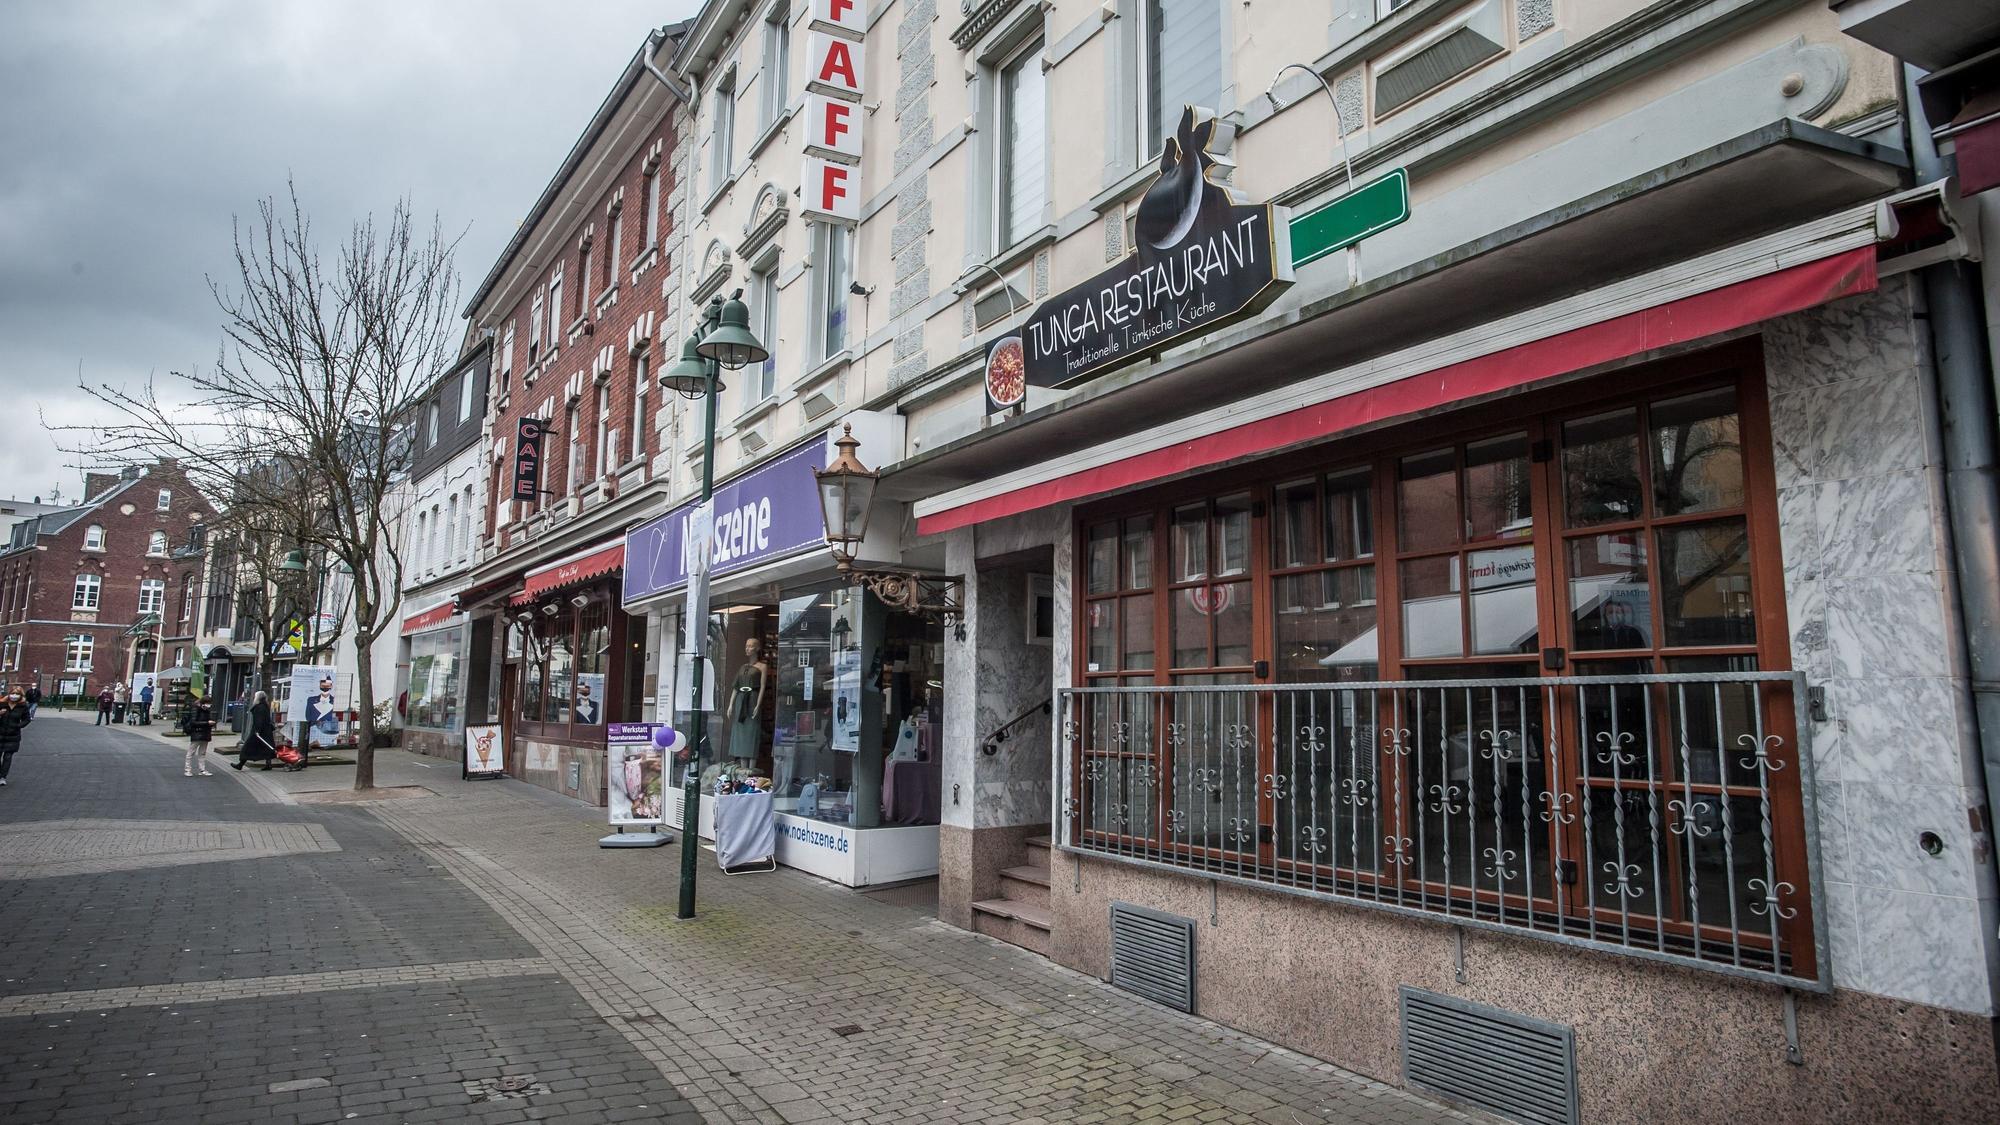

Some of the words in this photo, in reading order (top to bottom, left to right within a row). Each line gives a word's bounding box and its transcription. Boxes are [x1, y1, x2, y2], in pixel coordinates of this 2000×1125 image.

[1028, 297, 1099, 361] TUNGA
[1100, 214, 1258, 331] RESTAURANT
[1062, 332, 1120, 375] Traditionelle
[1121, 310, 1173, 351] Türkische
[1176, 291, 1216, 329] Küche
[517, 424, 539, 495] CAFE
[680, 496, 771, 576] Nszene
[953, 623, 967, 643] 46
[607, 734, 648, 742] Reparaturannahme
[621, 725, 648, 734] Werkstatt
